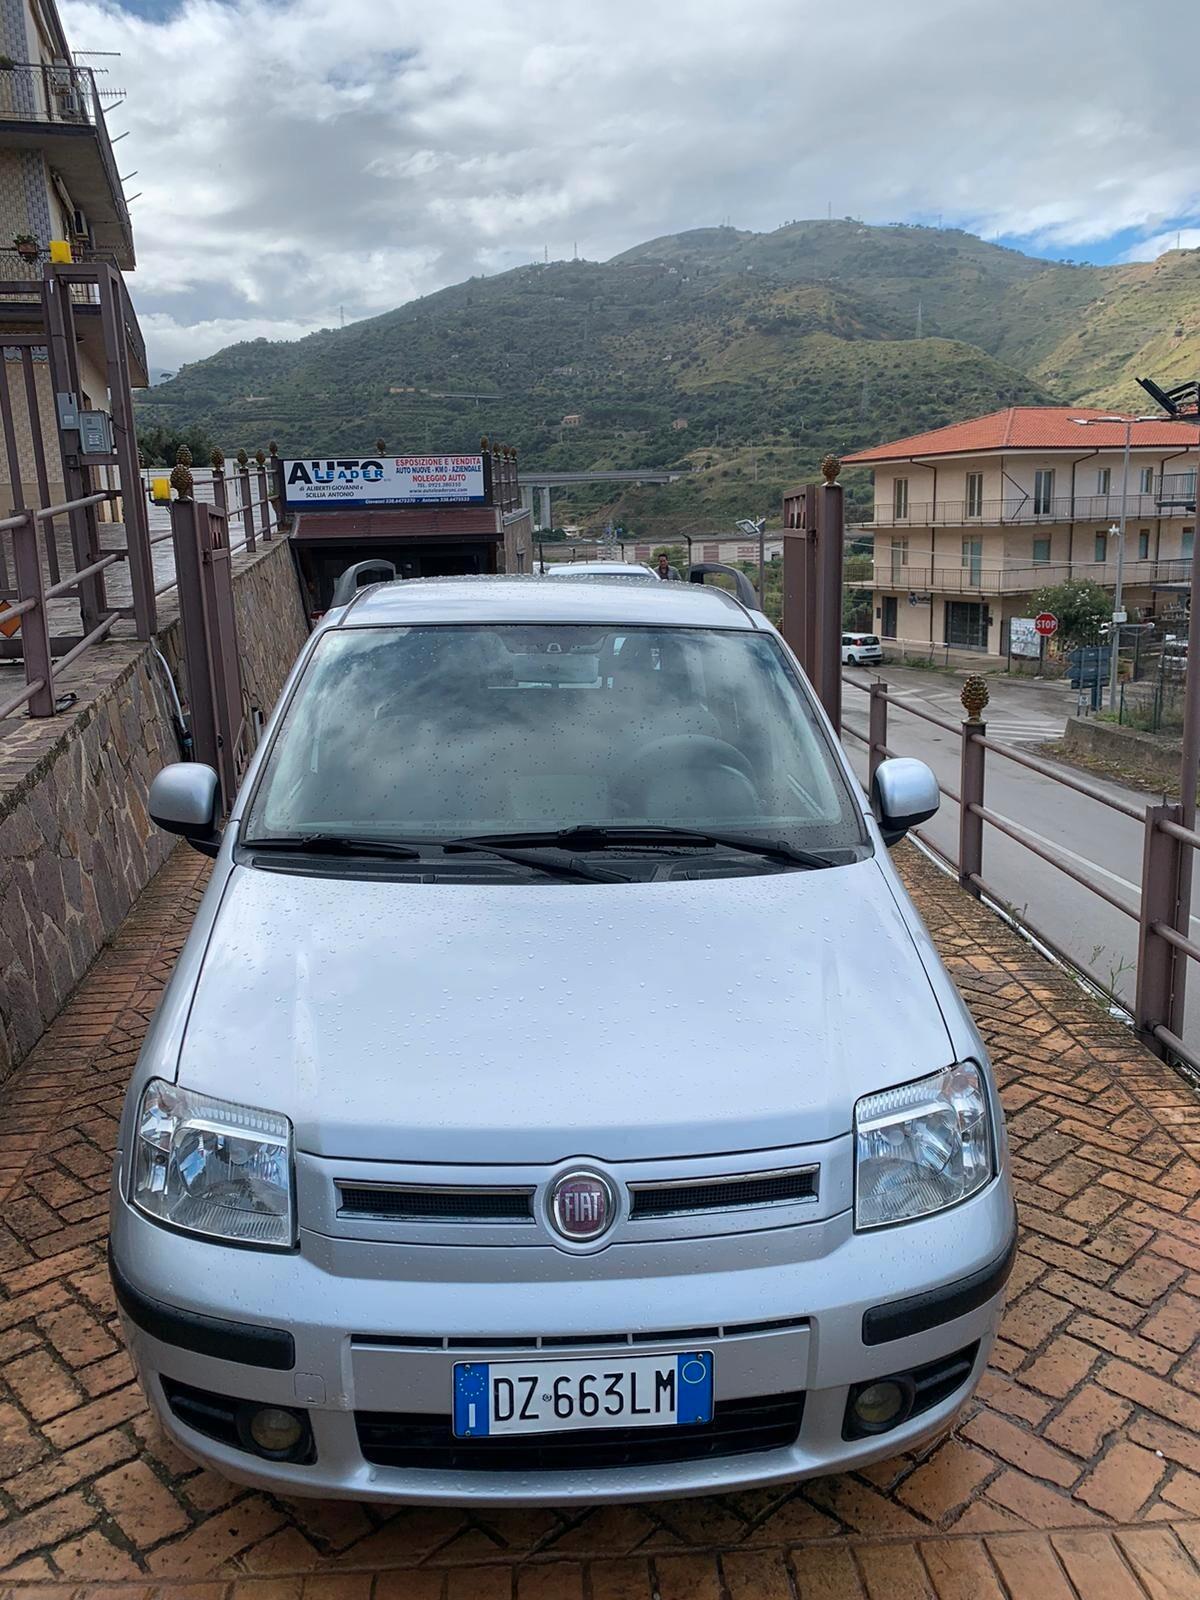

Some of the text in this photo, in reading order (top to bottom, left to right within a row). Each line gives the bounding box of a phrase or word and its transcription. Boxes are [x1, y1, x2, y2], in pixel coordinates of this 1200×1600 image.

[396, 458, 442, 466] ESPOSIZIONE
[451, 457, 481, 465] VENDITA
[287, 460, 384, 484] AUTO
[315, 469, 384, 480] LEADER
[396, 466, 411, 474] AUTO
[412, 474, 466, 483] NOLEGGIO AUTO
[1036, 619, 1057, 629] STOP
[564, 1191, 601, 1223] FIAT
